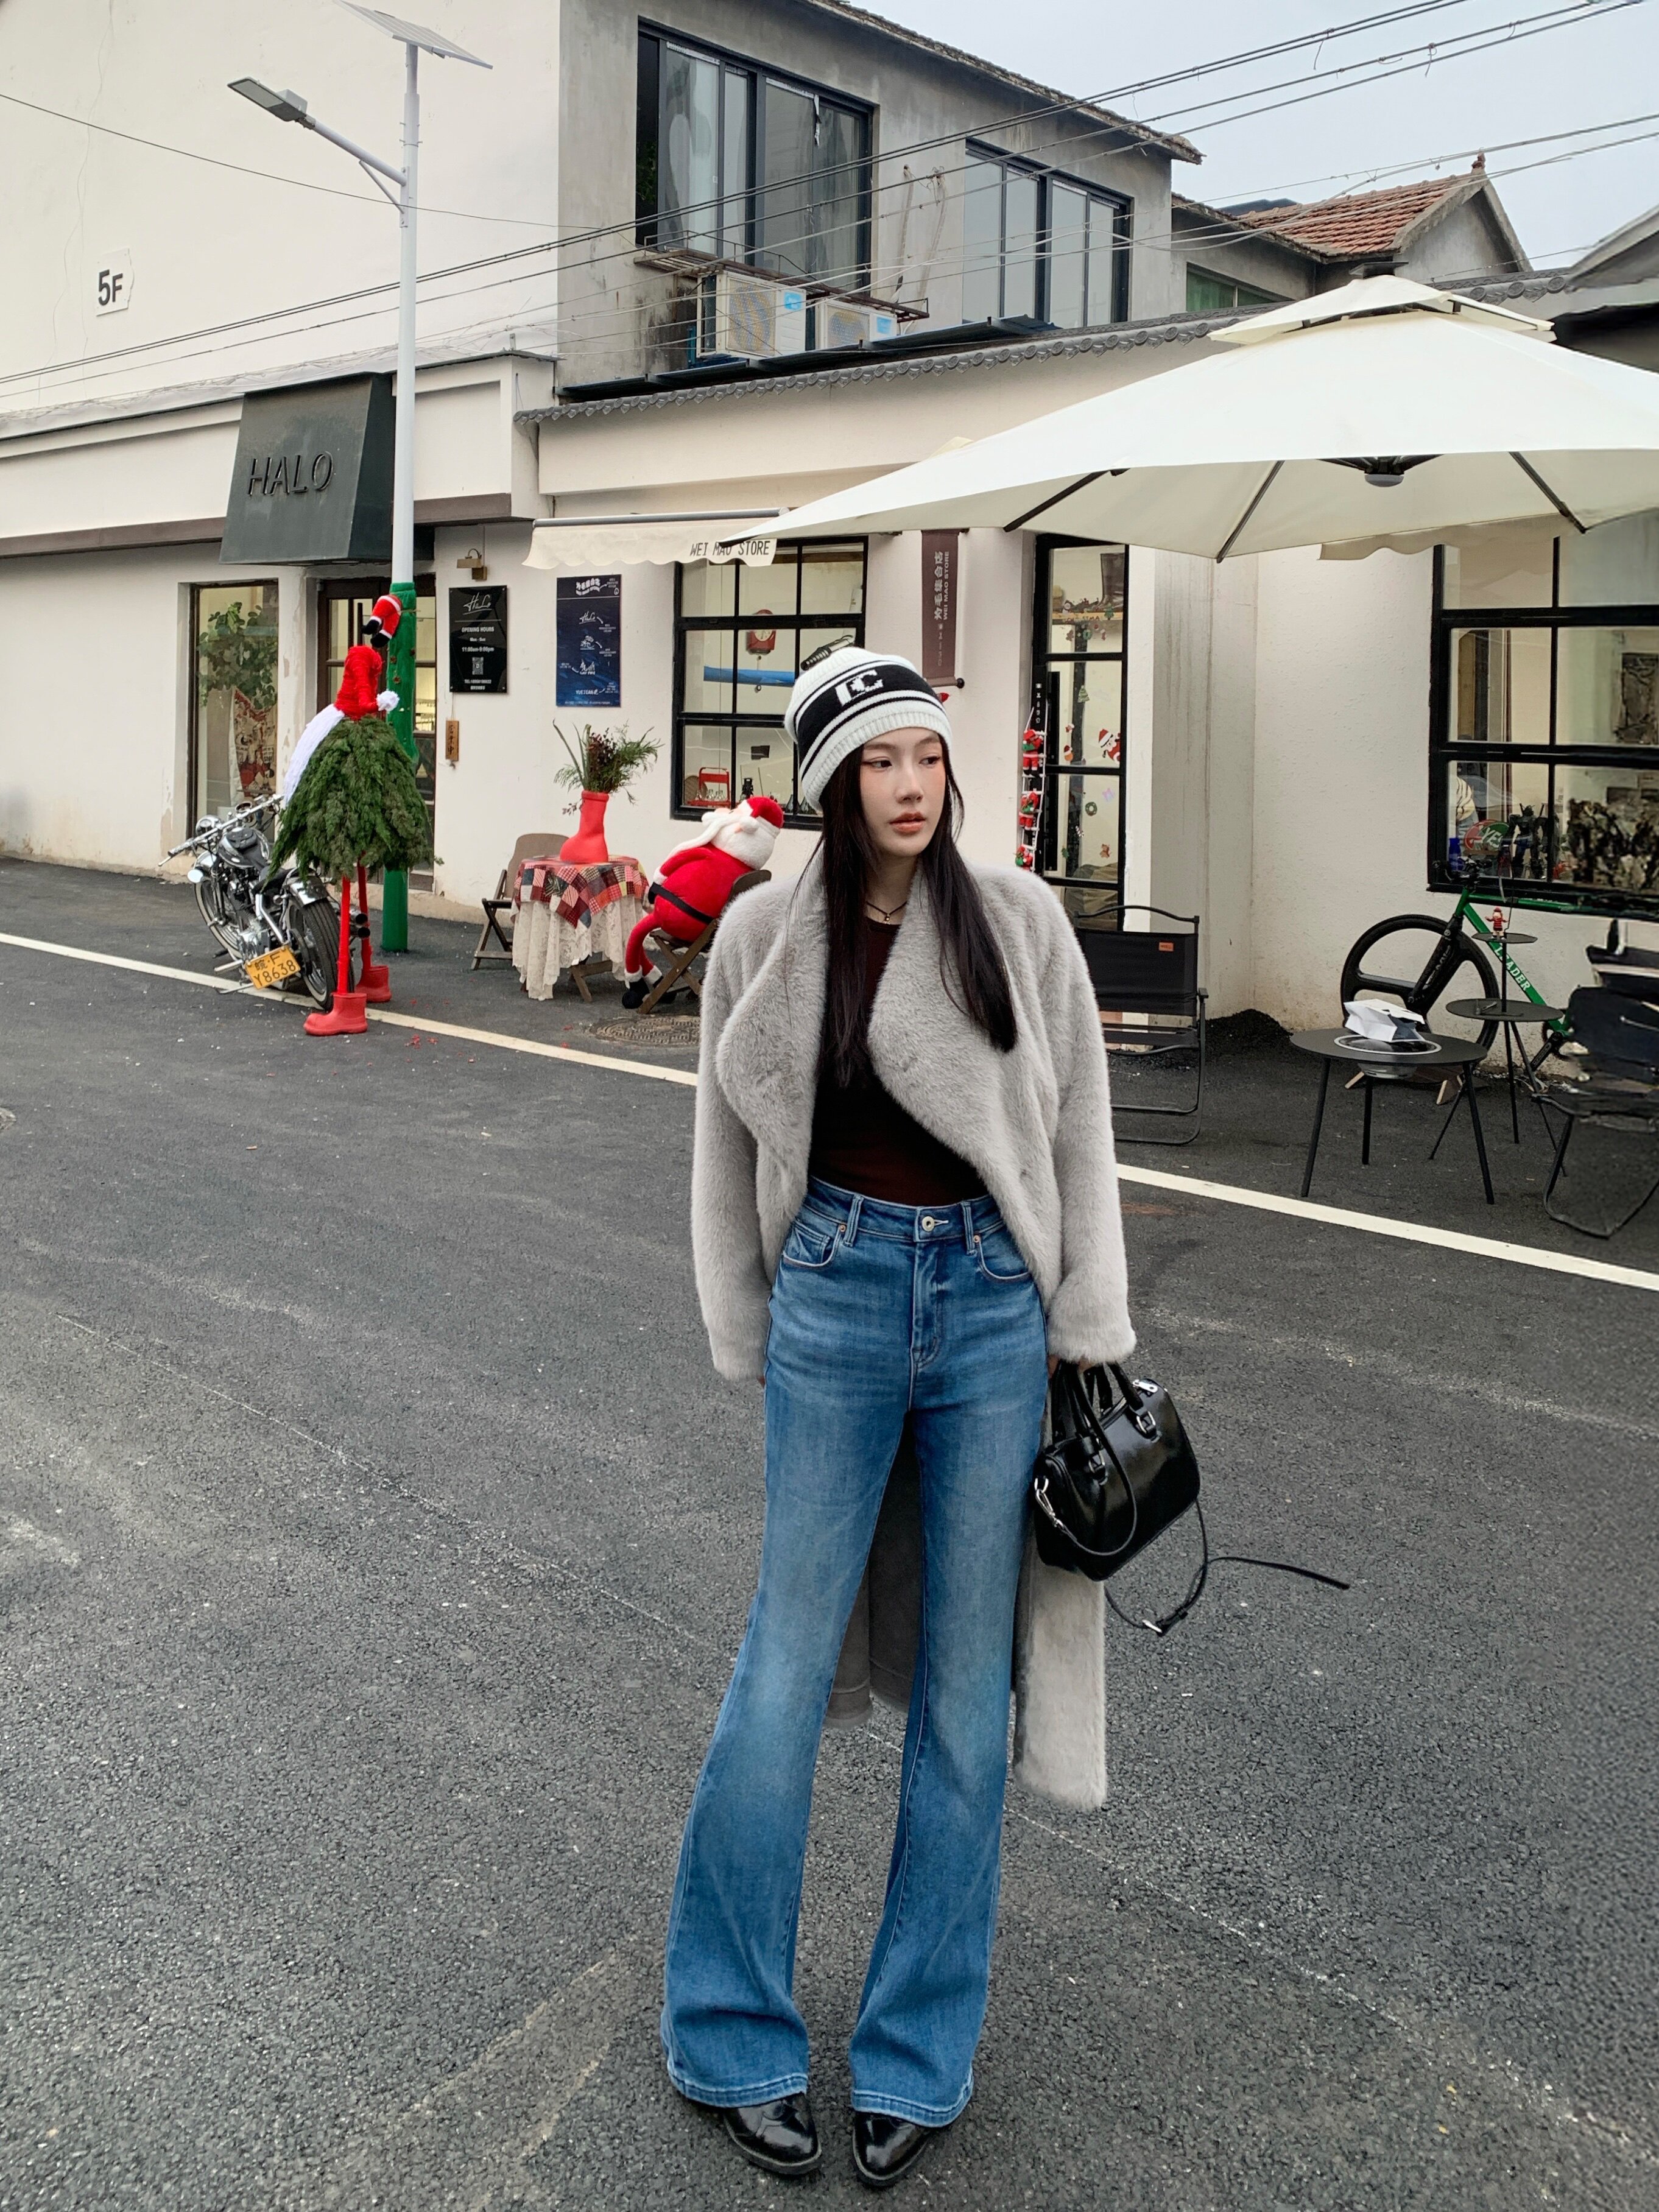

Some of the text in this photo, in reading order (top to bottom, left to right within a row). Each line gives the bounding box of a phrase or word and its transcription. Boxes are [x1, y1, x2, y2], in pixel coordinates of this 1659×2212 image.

[99, 269, 124, 306] 5F
[248, 451, 333, 496] HALO
[689, 542, 709, 557] WEI
[738, 540, 770, 555] STORE
[253, 960, 296, 987] Y8638
